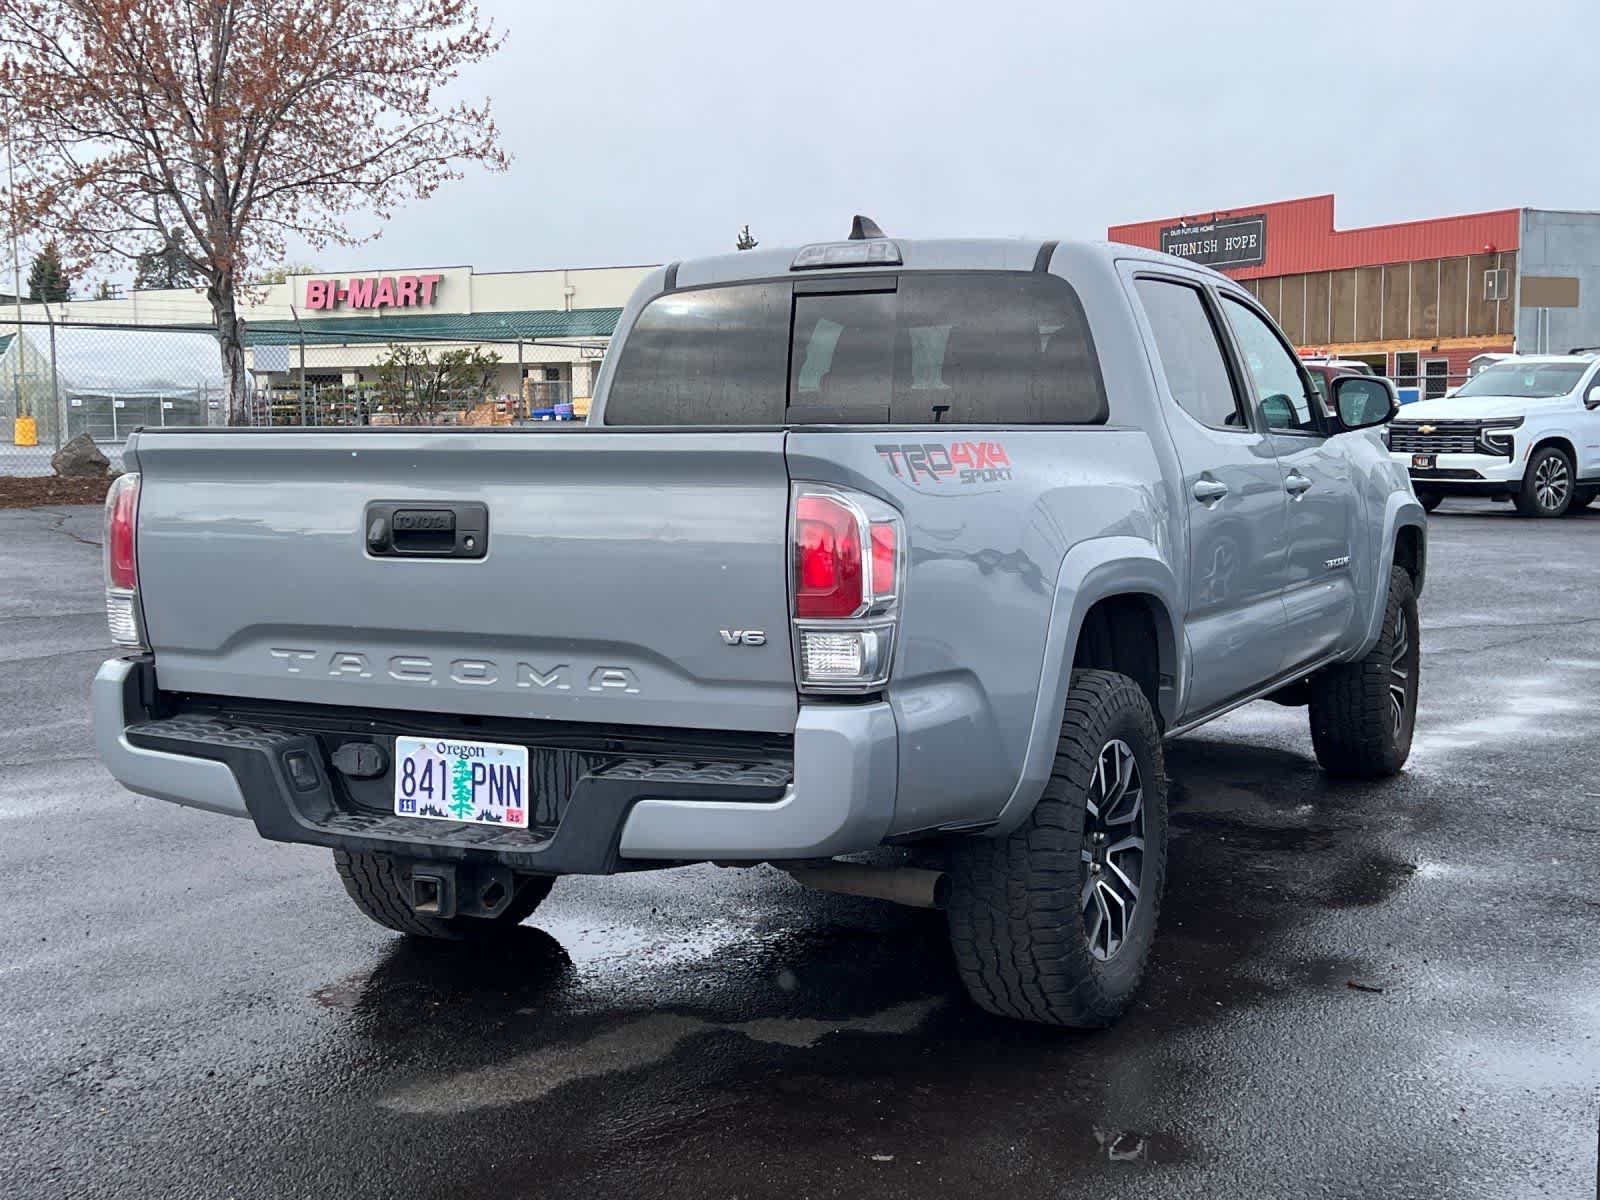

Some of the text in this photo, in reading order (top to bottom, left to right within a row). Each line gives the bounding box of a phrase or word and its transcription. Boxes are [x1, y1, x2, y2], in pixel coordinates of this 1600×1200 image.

[1168, 239, 1218, 256] FURNISH
[305, 274, 441, 310] BI-MART
[874, 443, 956, 485] TRD
[959, 467, 1012, 484] SPORT
[398, 513, 449, 529] TOYOTA
[719, 629, 766, 646] V6
[270, 647, 640, 694] TACOMA
[436, 741, 485, 760] Oregon
[402, 757, 521, 808] 841 PNN
